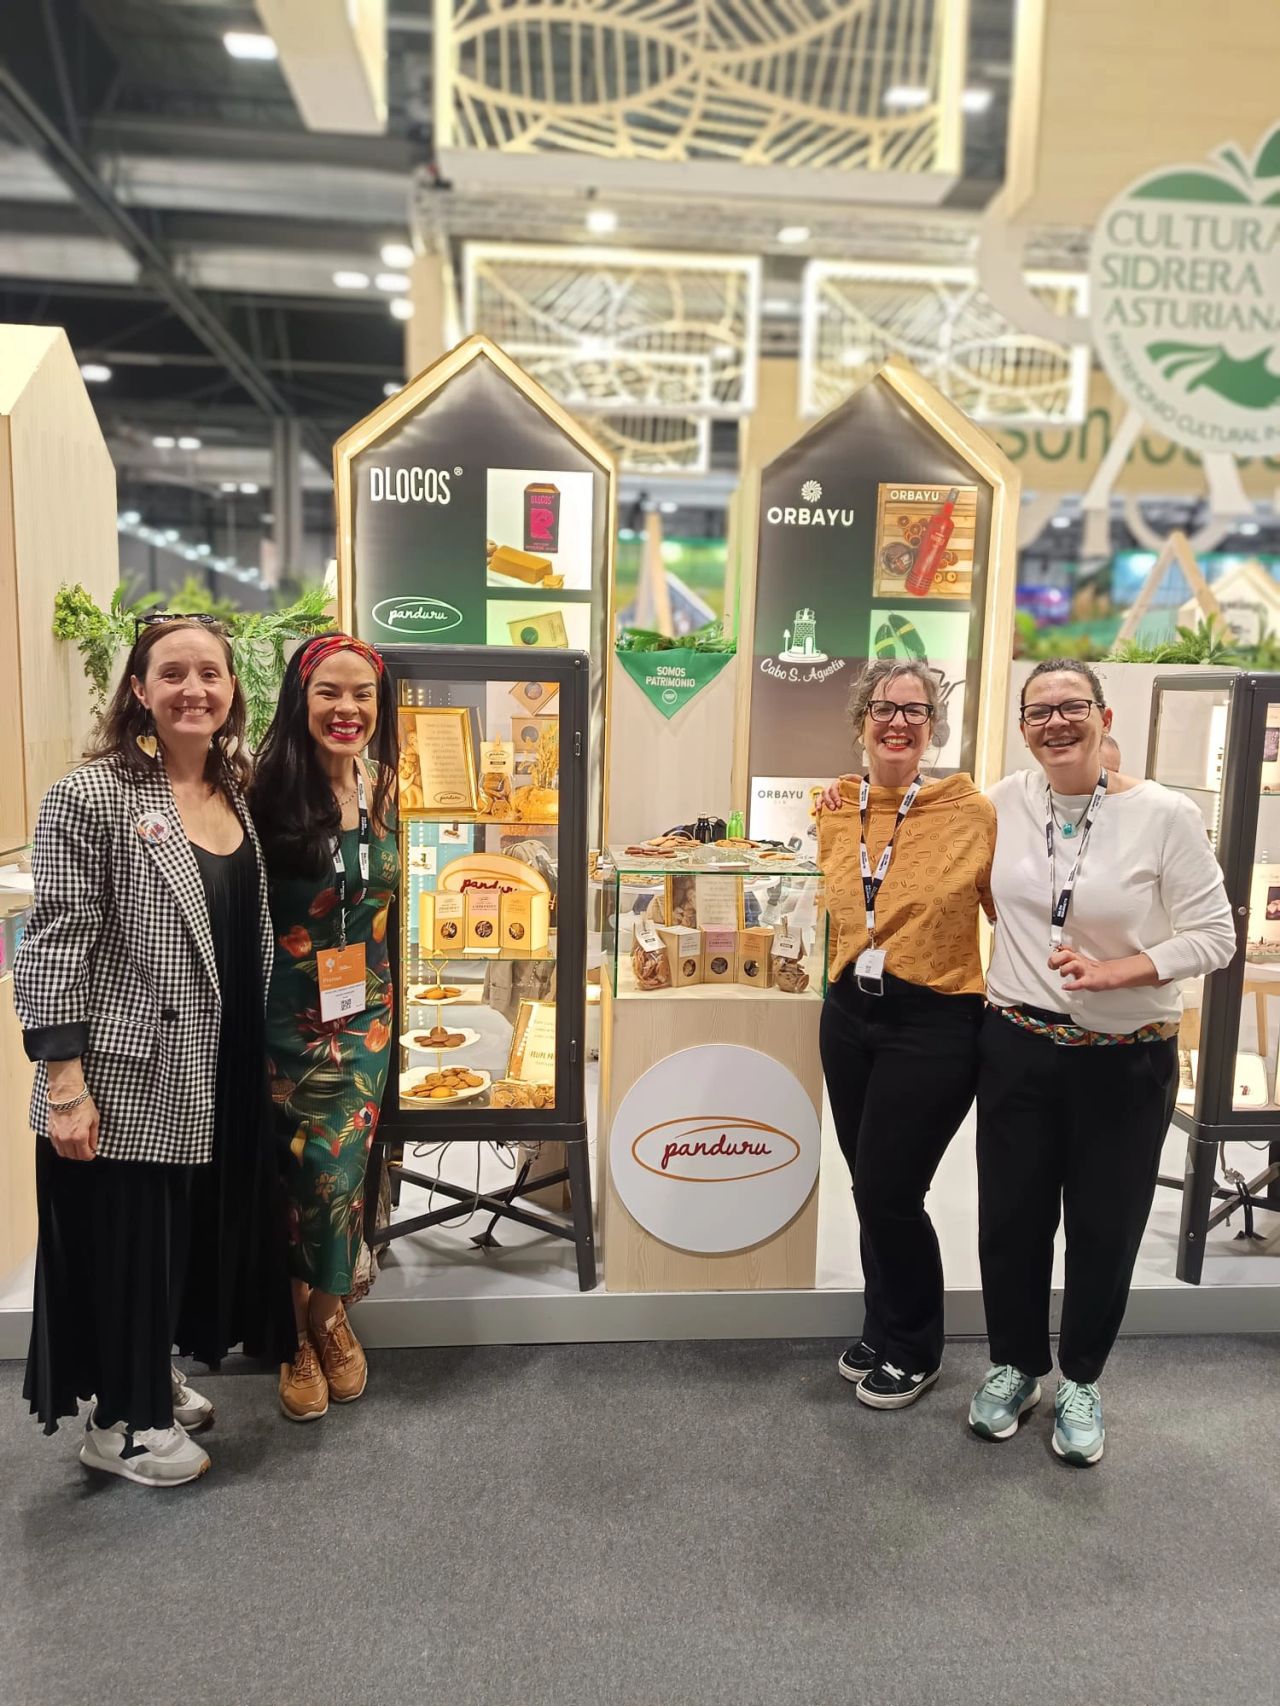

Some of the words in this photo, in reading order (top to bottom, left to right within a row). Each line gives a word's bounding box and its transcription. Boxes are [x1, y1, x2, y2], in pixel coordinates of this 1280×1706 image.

[1101, 252, 1263, 297] SIDRERA
[890, 489, 940, 501] ORBAYU
[767, 507, 855, 527] ORBAYU
[387, 605, 448, 625] panduru
[656, 666, 686, 677] SOMOS
[760, 658, 787, 682] Cabo
[788, 667, 801, 683] S.
[803, 659, 846, 684] Agustín
[645, 675, 696, 688] PATRIMONIO
[757, 789, 803, 799] ORBAYU
[661, 1134, 772, 1170] panduru
